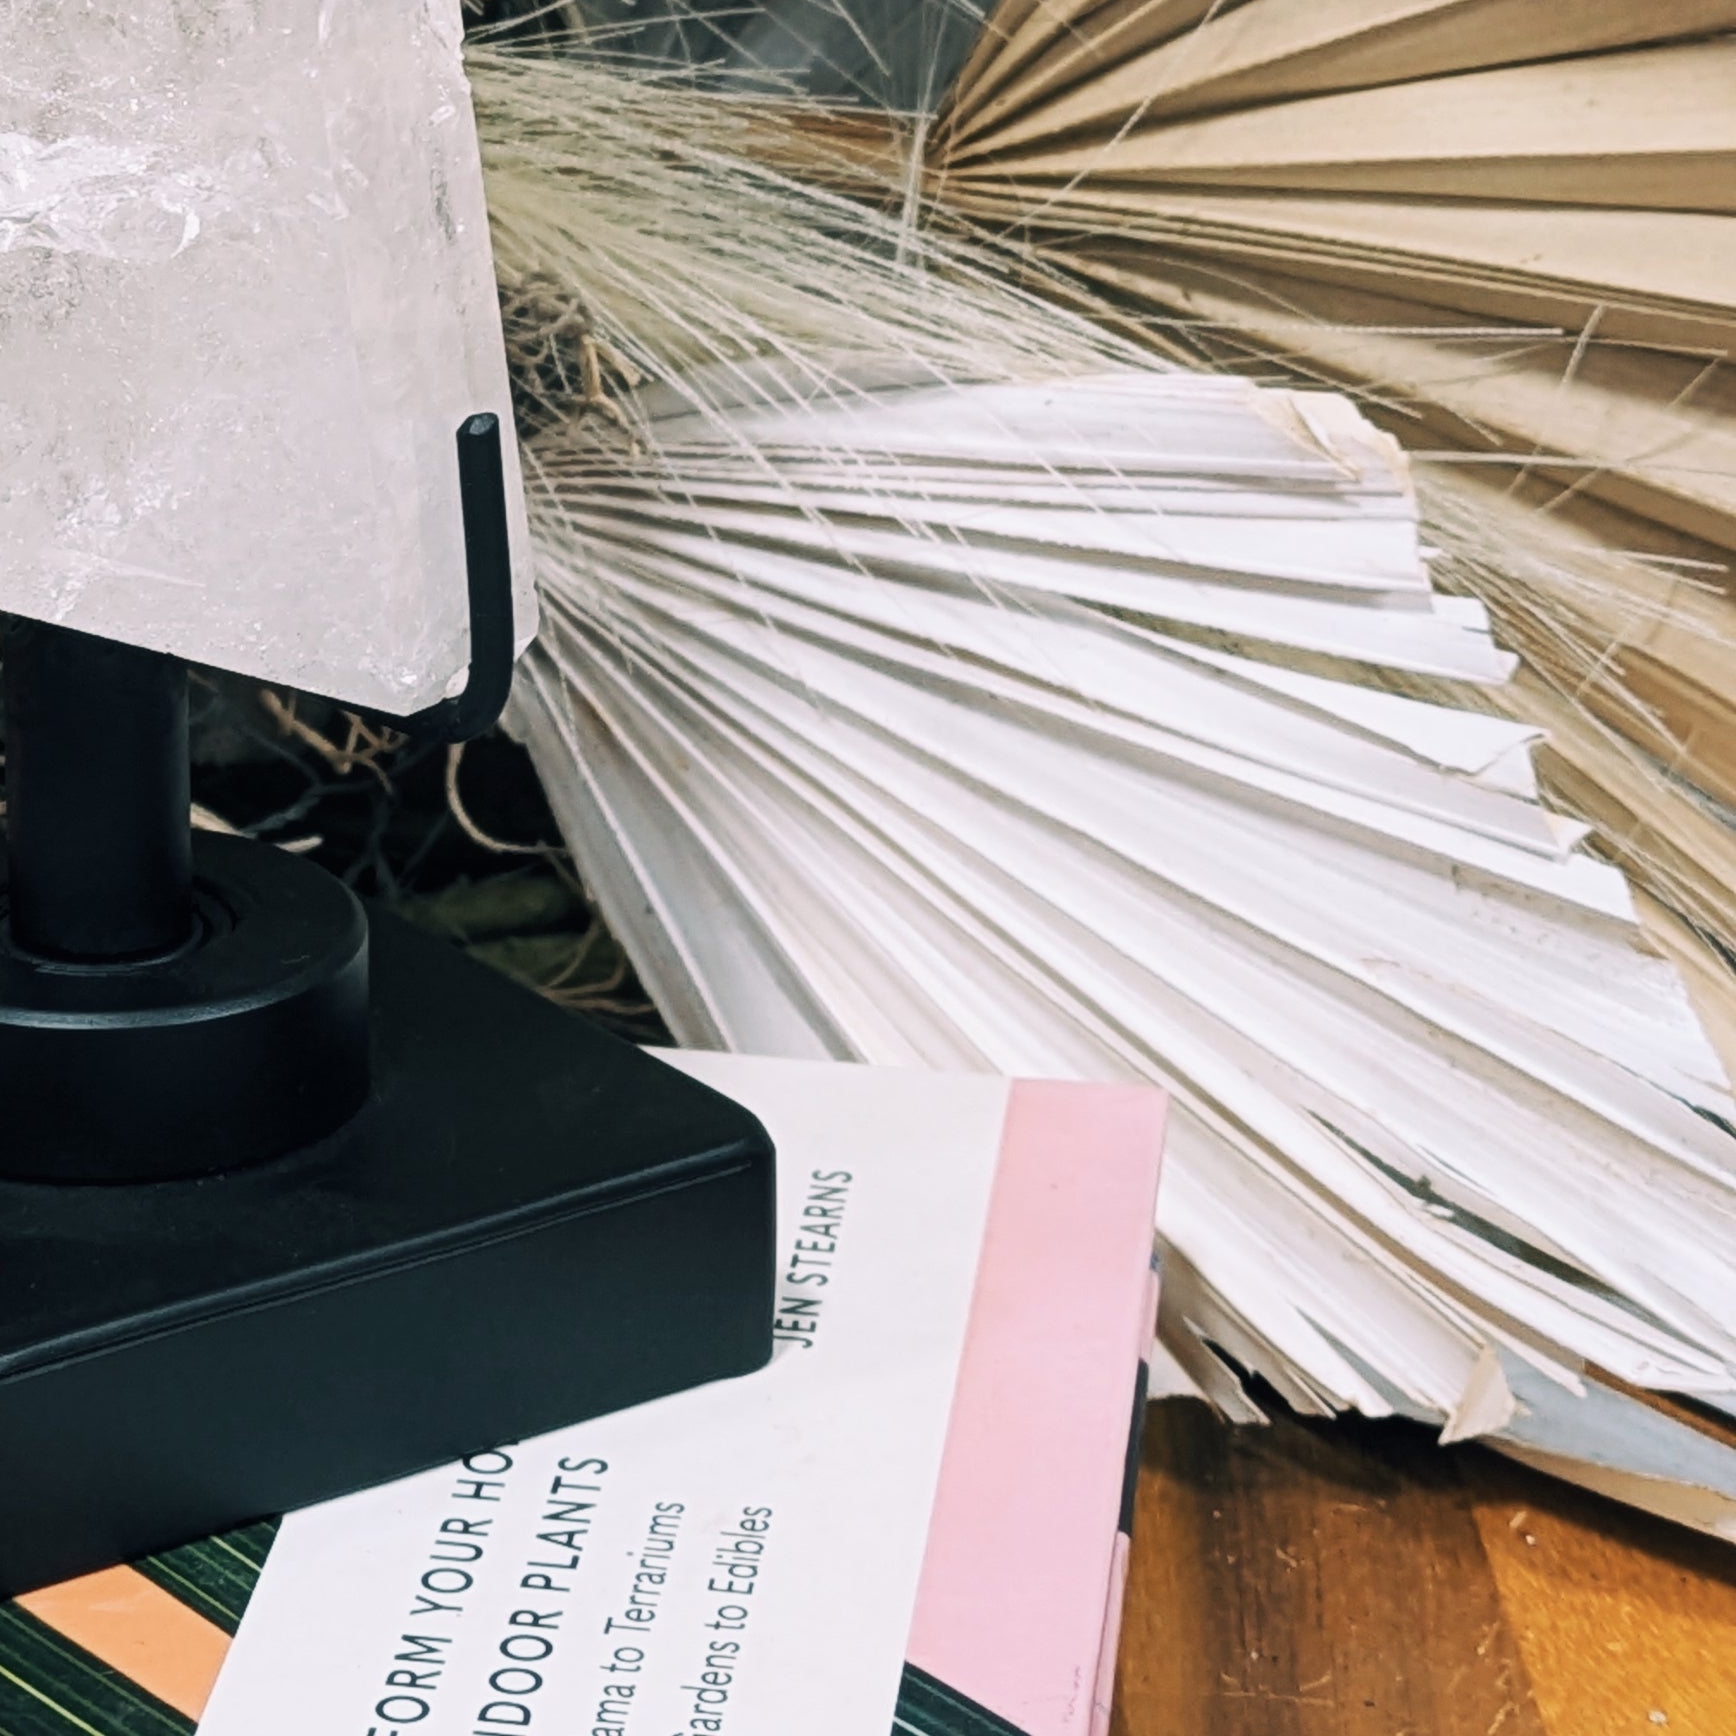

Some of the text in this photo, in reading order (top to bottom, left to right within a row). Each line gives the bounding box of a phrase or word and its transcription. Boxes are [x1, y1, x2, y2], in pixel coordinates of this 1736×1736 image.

[773, 1169, 853, 1349] JEN STEARNS
[409, 1517, 493, 1615] YOUR
[451, 1441, 519, 1501] HO
[472, 1457, 609, 1736] DOOR PLANTS
[603, 1501, 685, 1635] Terrariums
[599, 1646, 645, 1673] to
[671, 1506, 772, 1736] ardens to Edibles
